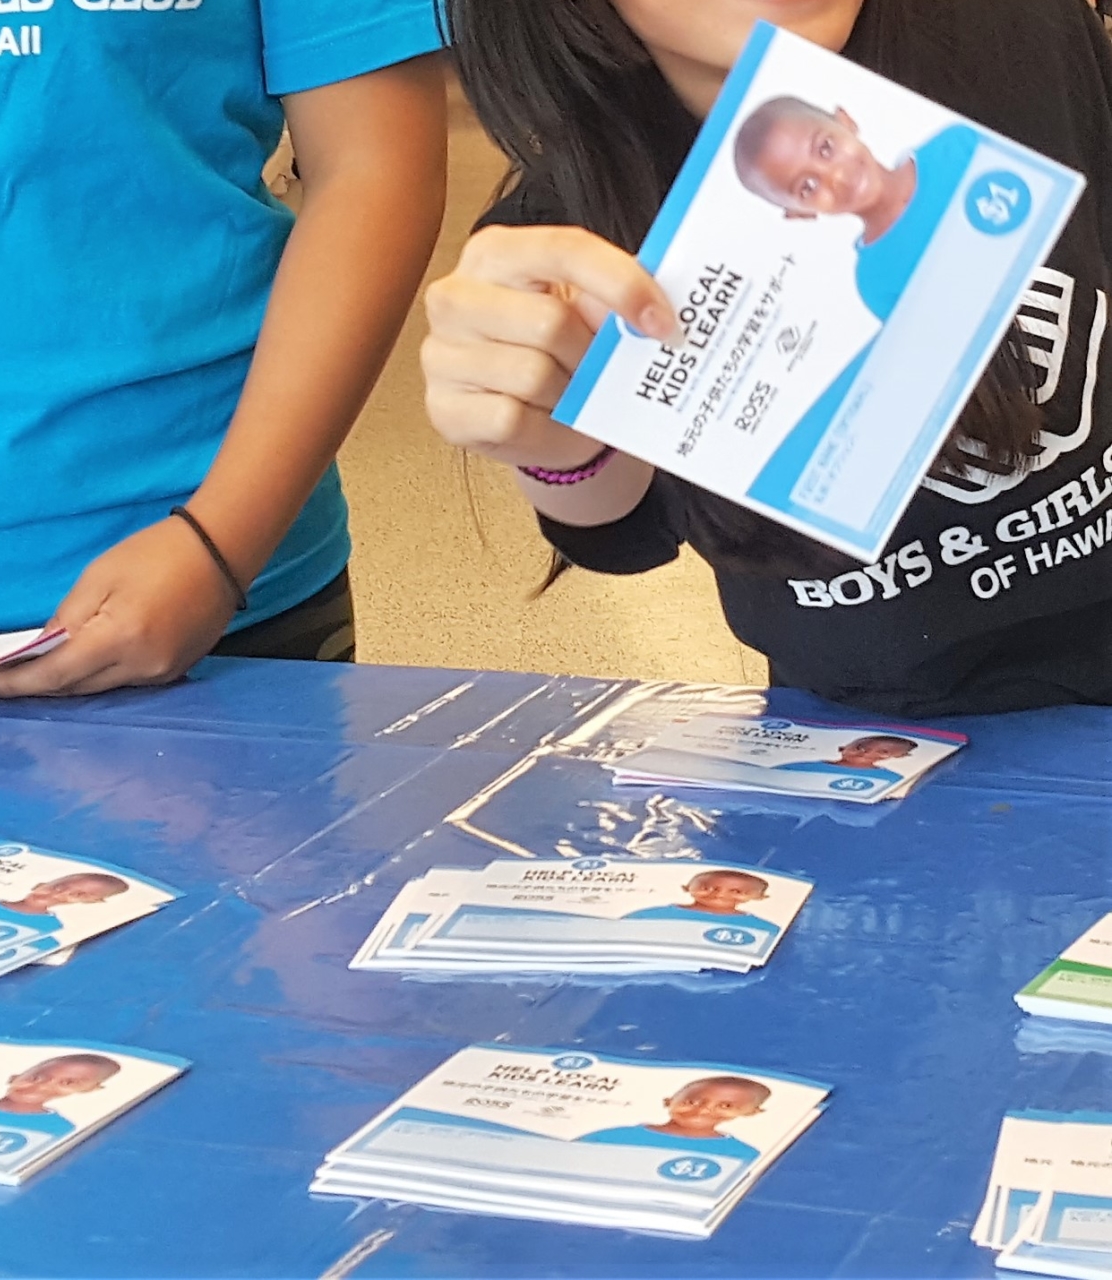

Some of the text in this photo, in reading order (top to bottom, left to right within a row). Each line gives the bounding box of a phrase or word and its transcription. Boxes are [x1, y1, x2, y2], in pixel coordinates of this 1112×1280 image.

[976, 180, 1020, 227] $1
[657, 351, 698, 408] KIDS
[688, 270, 743, 350] LEARN
[734, 380, 772, 431] ROSS
[788, 540, 933, 608] BOYS
[939, 526, 990, 566] &
[970, 509, 1112, 599] OF HAW
[487, 1071, 616, 1093] KIDS LEARN
[494, 1063, 622, 1086] HELP LOCAL
[669, 1156, 709, 1178] $1
